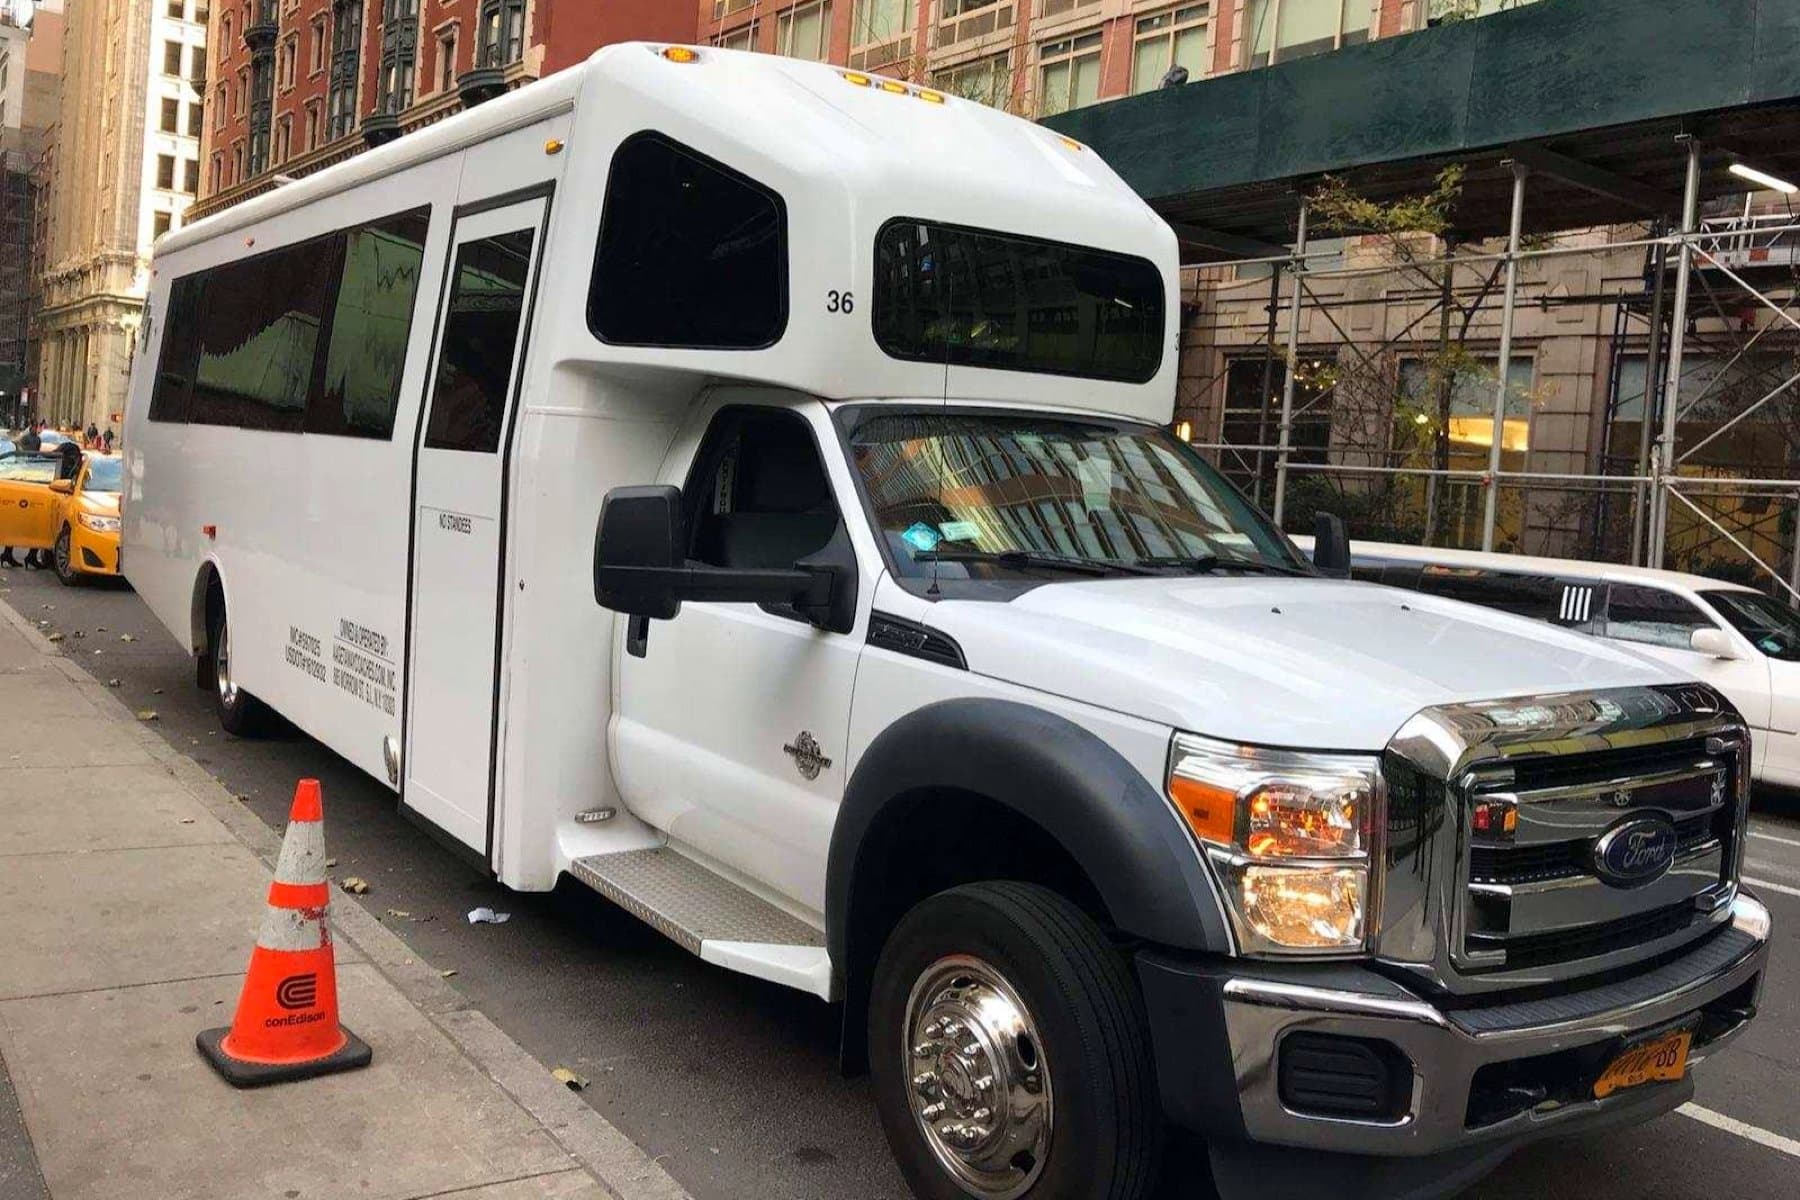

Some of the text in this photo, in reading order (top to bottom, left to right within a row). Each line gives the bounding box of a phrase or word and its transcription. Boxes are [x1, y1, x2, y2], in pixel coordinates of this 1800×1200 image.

[827, 289, 854, 314] 36
[439, 512, 472, 534] NO STANDEES
[1623, 831, 1666, 868] Ford
[265, 1011, 326, 1028] conEdison
